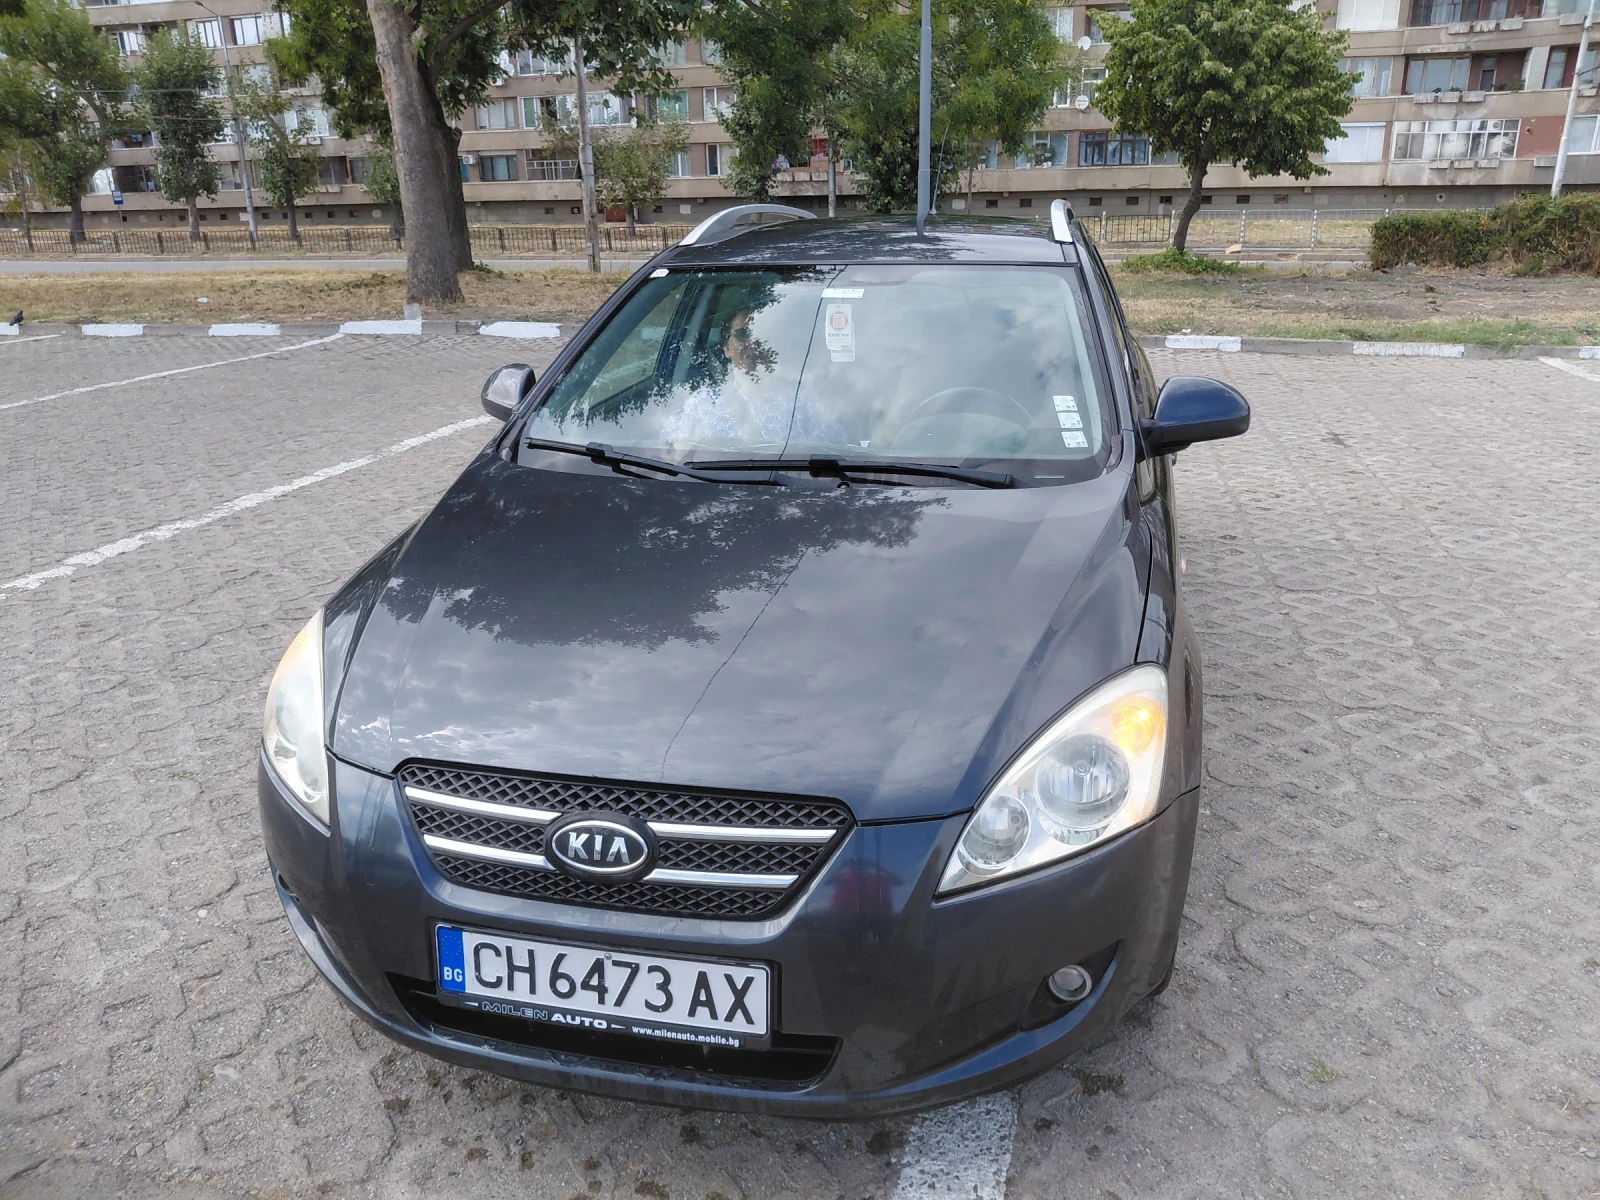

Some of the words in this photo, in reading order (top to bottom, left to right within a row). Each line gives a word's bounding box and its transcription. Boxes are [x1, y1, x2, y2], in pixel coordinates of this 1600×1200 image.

[567, 831, 631, 864] KIA
[443, 966, 463, 982] BG
[473, 941, 536, 995] CH
[549, 952, 674, 1013] 6473
[687, 970, 756, 1026] AX
[482, 1001, 548, 1020] MILEN
[551, 1013, 608, 1029] AUTO
[632, 1025, 740, 1048] www.milenauto.mobile.bg
